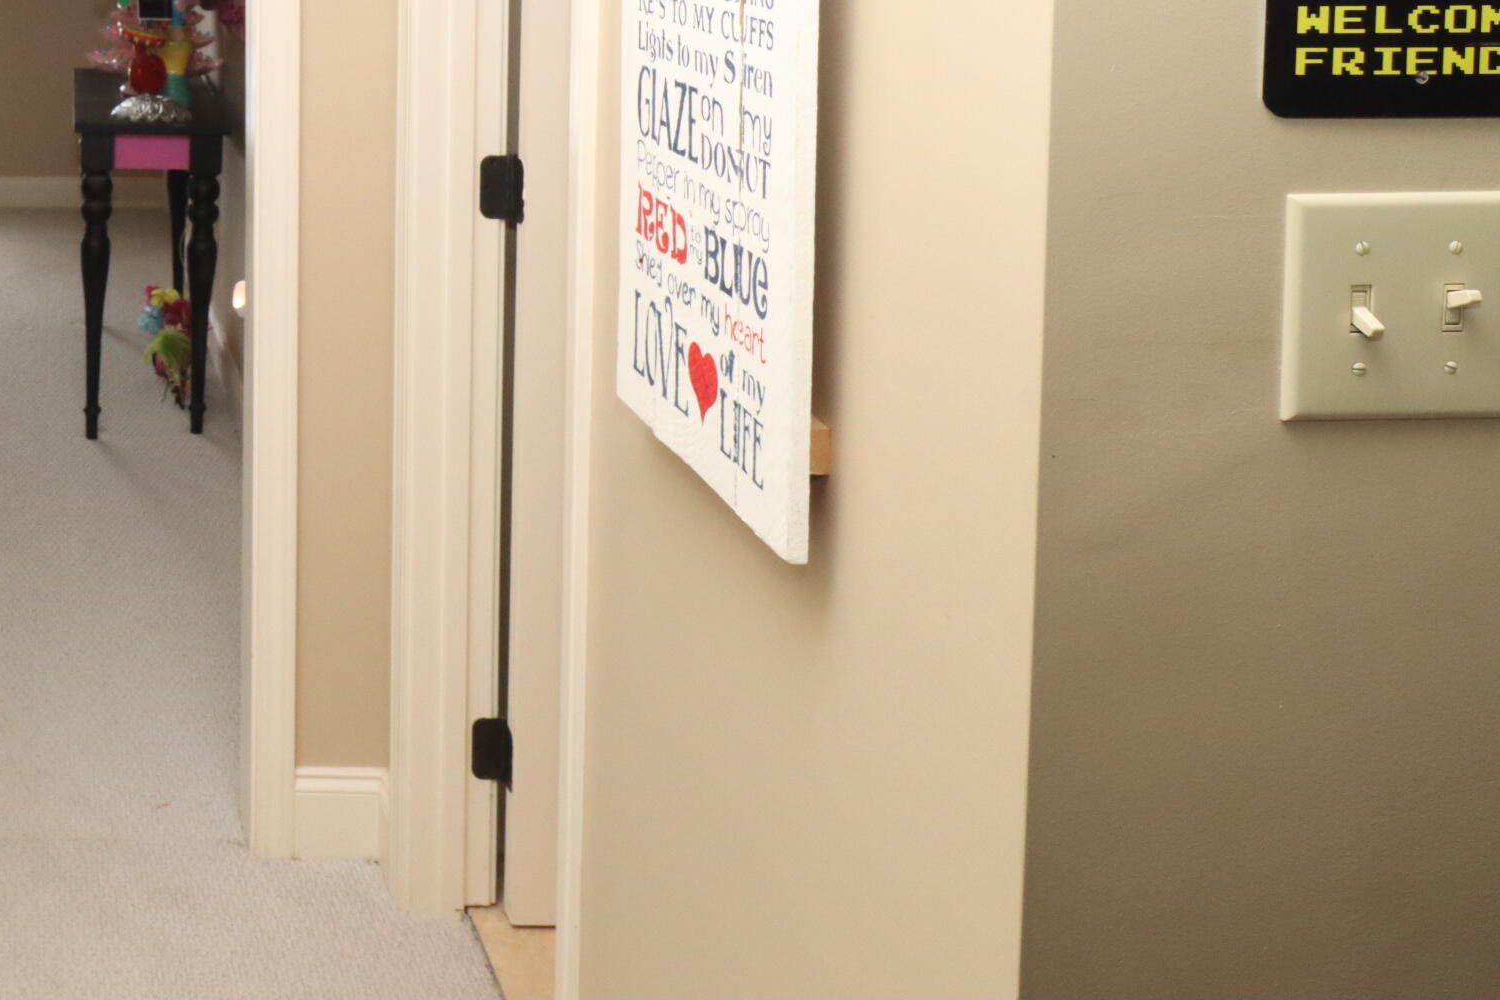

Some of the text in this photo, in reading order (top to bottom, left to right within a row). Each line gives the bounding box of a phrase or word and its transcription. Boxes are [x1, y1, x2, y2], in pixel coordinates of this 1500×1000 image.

[677, 33, 691, 69] to
[694, 49, 719, 89] my
[692, 2, 716, 35] MY
[637, 65, 773, 165] GLAZE on my
[635, 180, 688, 266] RED
[703, 224, 769, 321] BLUE
[682, 169, 697, 205] in
[698, 181, 721, 226] my
[724, 198, 771, 254] spray
[633, 288, 690, 418] LOVE
[741, 368, 766, 416] my
[667, 272, 697, 310] over
[700, 293, 721, 337] my
[723, 302, 767, 365] heart
[719, 387, 765, 492] LIFE
